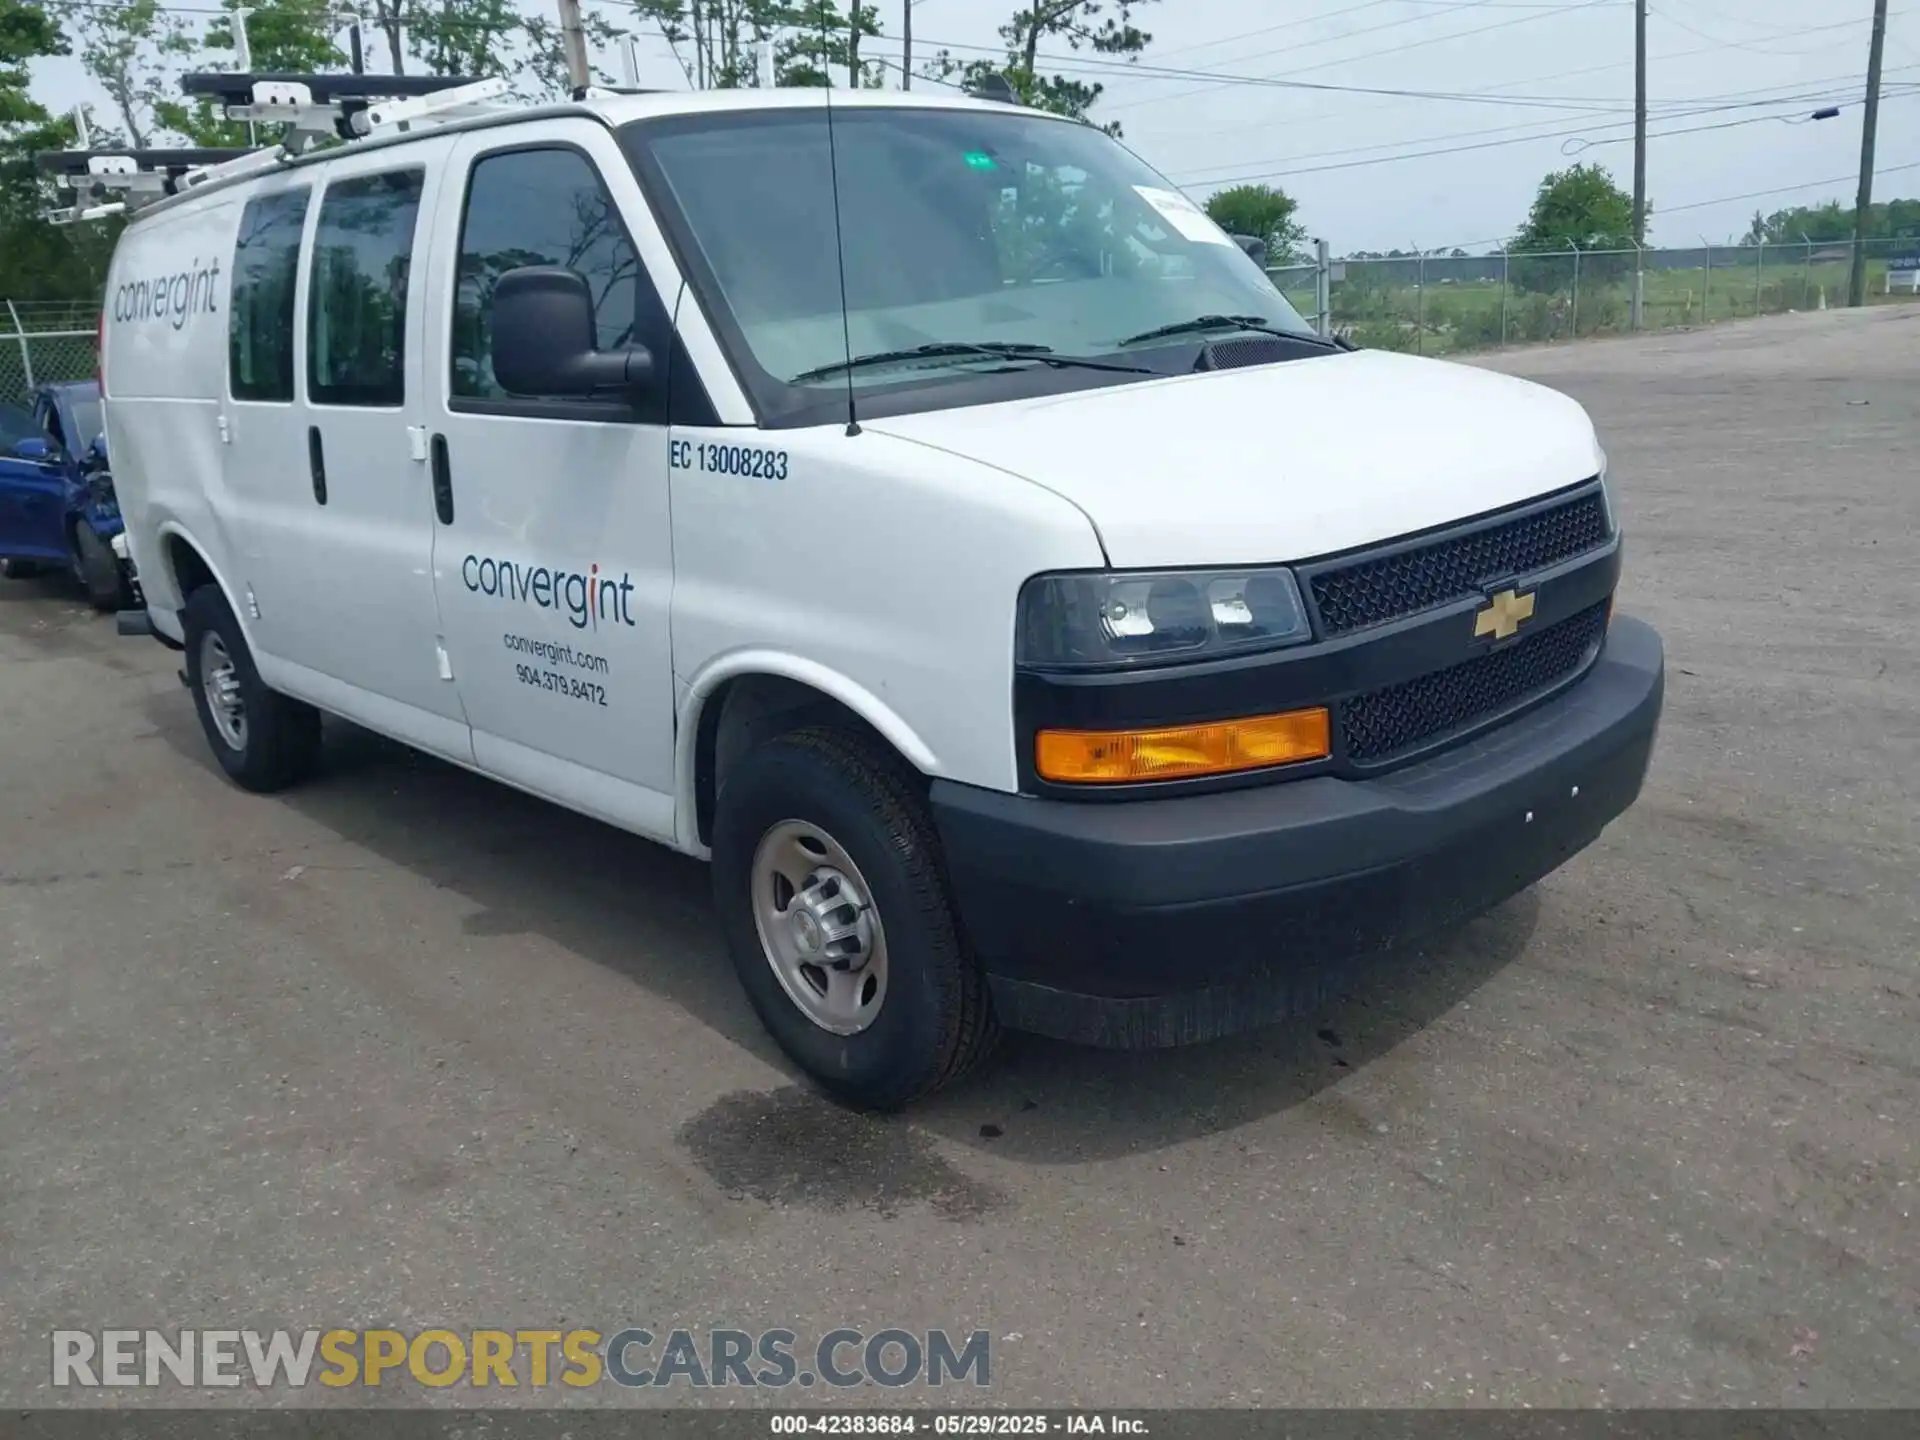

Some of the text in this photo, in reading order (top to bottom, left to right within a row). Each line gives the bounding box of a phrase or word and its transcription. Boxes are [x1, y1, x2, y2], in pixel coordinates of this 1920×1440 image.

[115, 256, 220, 331] convergint
[670, 439, 788, 480] EC 13008283
[462, 554, 636, 633] convergint
[503, 633, 609, 674] convergint.com
[516, 663, 608, 707] 904.379.8472
